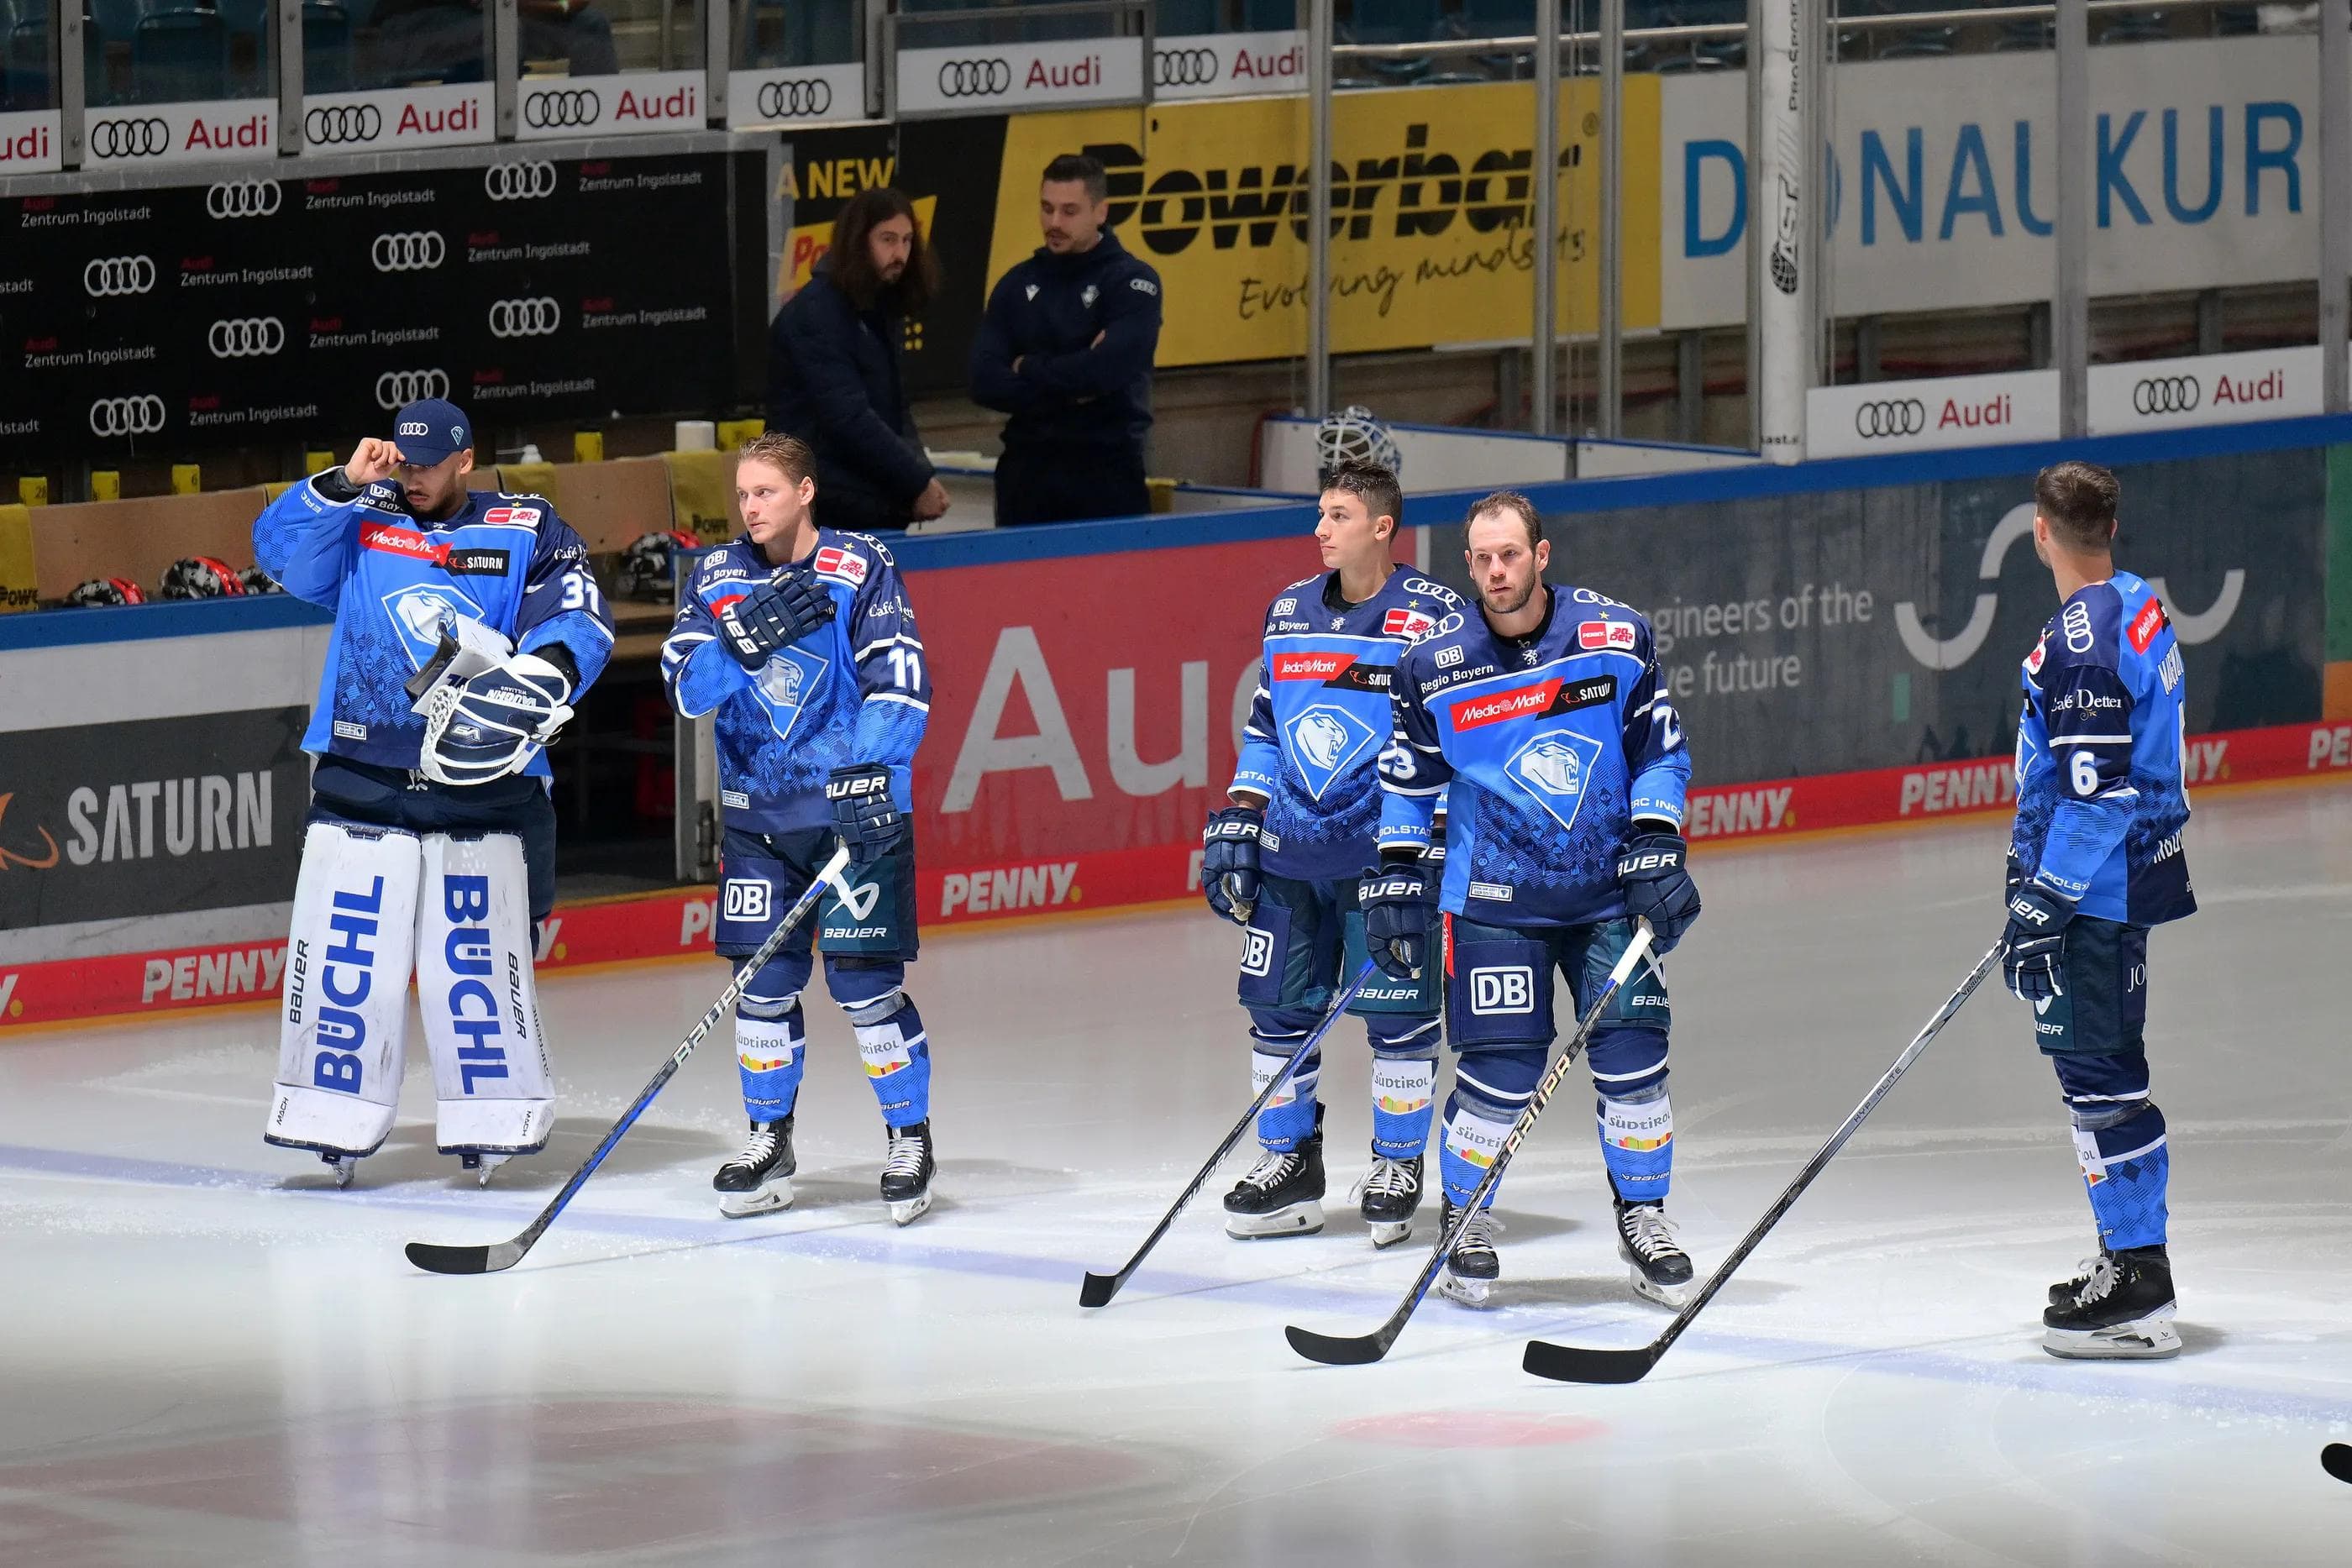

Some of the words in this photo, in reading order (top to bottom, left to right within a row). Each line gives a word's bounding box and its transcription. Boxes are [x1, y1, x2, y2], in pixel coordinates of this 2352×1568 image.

[1026, 54, 1102, 89] Audi
[1231, 45, 1305, 78] Audi
[396, 100, 479, 135] Audi
[615, 87, 696, 121] Audi
[0, 128, 49, 160] udi
[184, 116, 268, 150] Audi
[579, 177, 635, 191] Zentrum
[637, 170, 702, 189] Ingolstadt
[774, 161, 800, 201] A
[808, 157, 895, 199] NEW
[1082, 124, 1581, 254] Powerba
[1684, 101, 2304, 260] DNAUKUR
[306, 194, 364, 210] Zentrum
[367, 188, 435, 207] Ingolstadt
[21, 212, 80, 228] Zentrum
[83, 205, 152, 225] Ingolstadt
[468, 248, 522, 263] Zentrum
[525, 240, 591, 260] Ingolstadt
[1415, 217, 1588, 281] mindsts
[181, 271, 239, 287] Zentrum
[242, 265, 313, 285] Ingolstadt
[583, 312, 636, 328] Zentrum
[639, 306, 706, 325] Ingolstadt
[309, 332, 367, 348] Zentrum
[370, 326, 439, 345] Ingolstadt
[24, 352, 84, 369] Zentrum
[87, 344, 156, 364] Ingolstadt
[473, 383, 528, 399] Zentrum
[530, 376, 596, 396] Ingolstadt
[2213, 370, 2285, 406] Audi
[189, 410, 246, 427] Zentrum
[248, 403, 318, 423] Ingolstadt
[1939, 394, 2012, 429] Audi
[467, 556, 503, 570] SATURN
[706, 552, 726, 568] DB
[560, 572, 601, 616] 31
[869, 597, 895, 618] Café
[1276, 600, 1294, 613] DB
[1780, 584, 1814, 629] of
[1819, 581, 1873, 626] the
[1614, 627, 1629, 636] 30
[886, 646, 922, 694] 11
[1437, 649, 1461, 665] DB
[1704, 650, 1801, 696] future
[1420, 674, 1450, 694] Regio
[1452, 664, 1494, 681] Bayern
[486, 689, 537, 707] VAUGHN
[1460, 690, 1546, 725] MediaMarkt
[940, 624, 1263, 814] Au
[2071, 751, 2099, 797] 6
[66, 770, 272, 866] SATURN
[727, 883, 767, 916] DB
[313, 875, 384, 1095] BÜCHL
[444, 874, 509, 1095] BÜCHL
[1477, 973, 1528, 1008] DB
[276, 1096, 290, 1126] MACH
[521, 1110, 532, 1137] MACH
